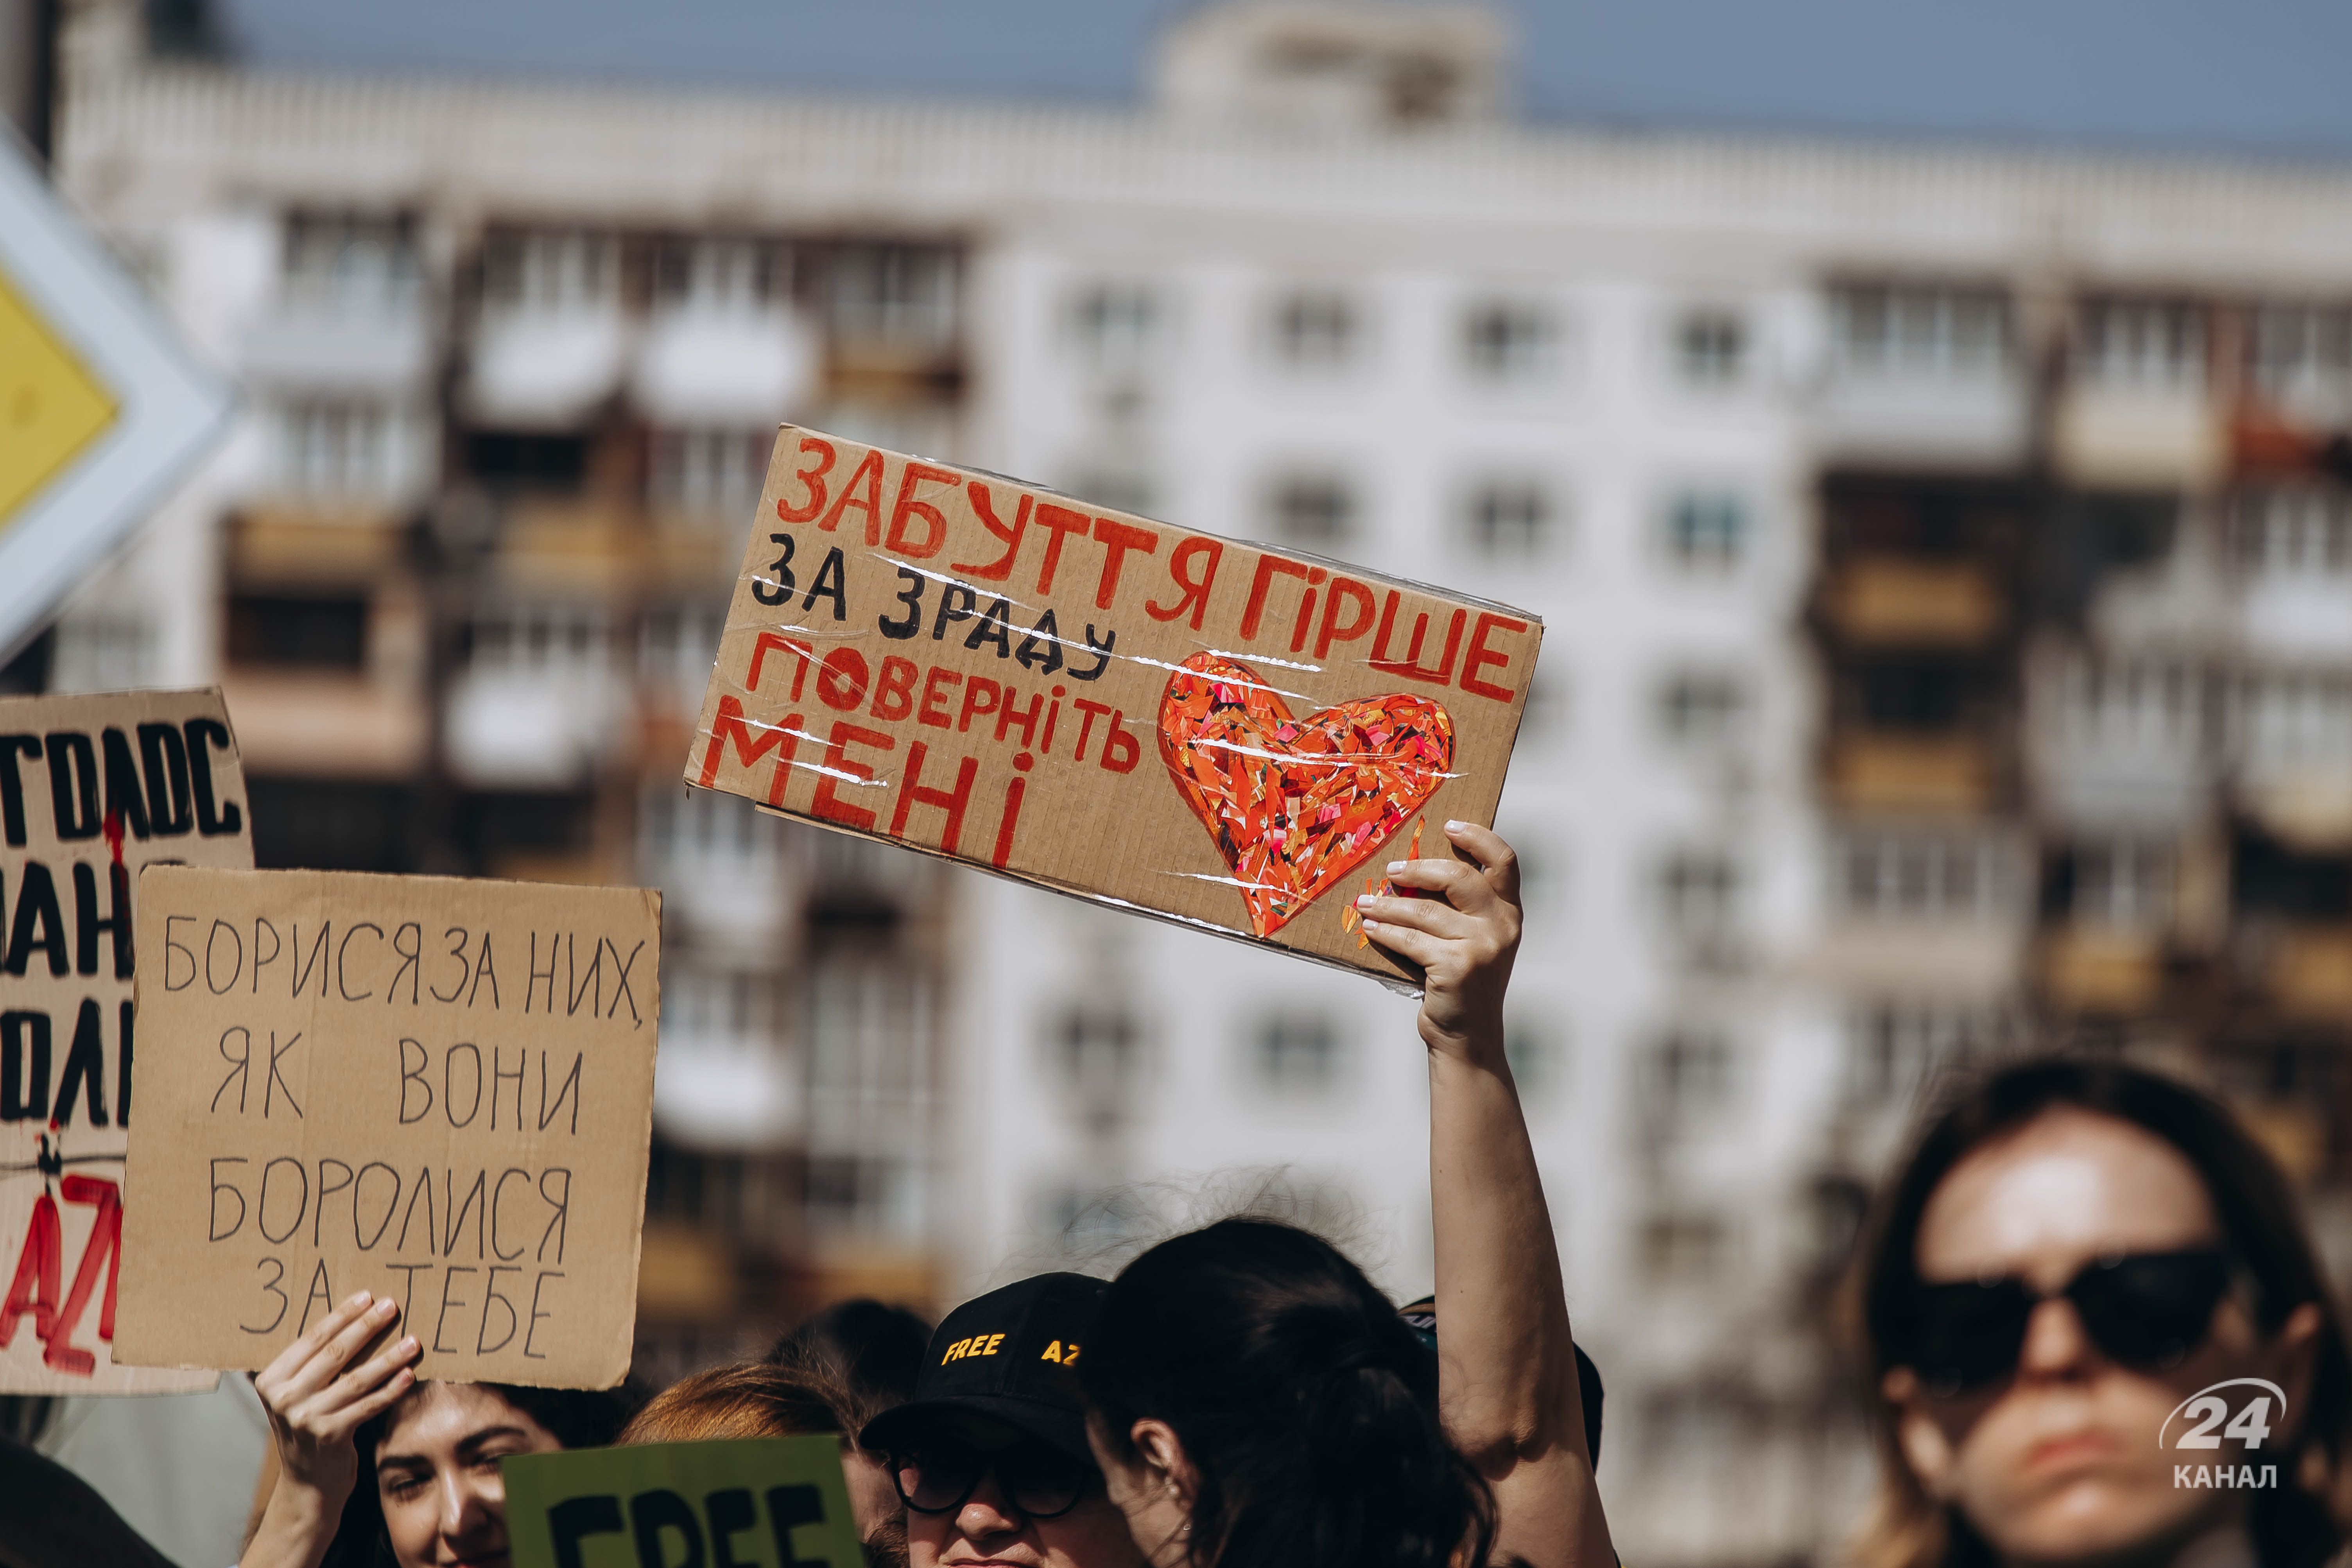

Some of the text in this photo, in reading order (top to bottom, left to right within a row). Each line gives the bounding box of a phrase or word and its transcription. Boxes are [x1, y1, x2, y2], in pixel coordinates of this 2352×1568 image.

[777, 438, 1223, 631] ЗАБУТТЯ
[751, 534, 1116, 681] ЗА ЗРАДУ
[211, 1027, 582, 1134] ЯК ВОНИ
[209, 1157, 571, 1265] БОРОЛИСЯ
[239, 1257, 565, 1358] ЗА ТЕБЕ
[941, 1333, 1006, 1366] FREE
